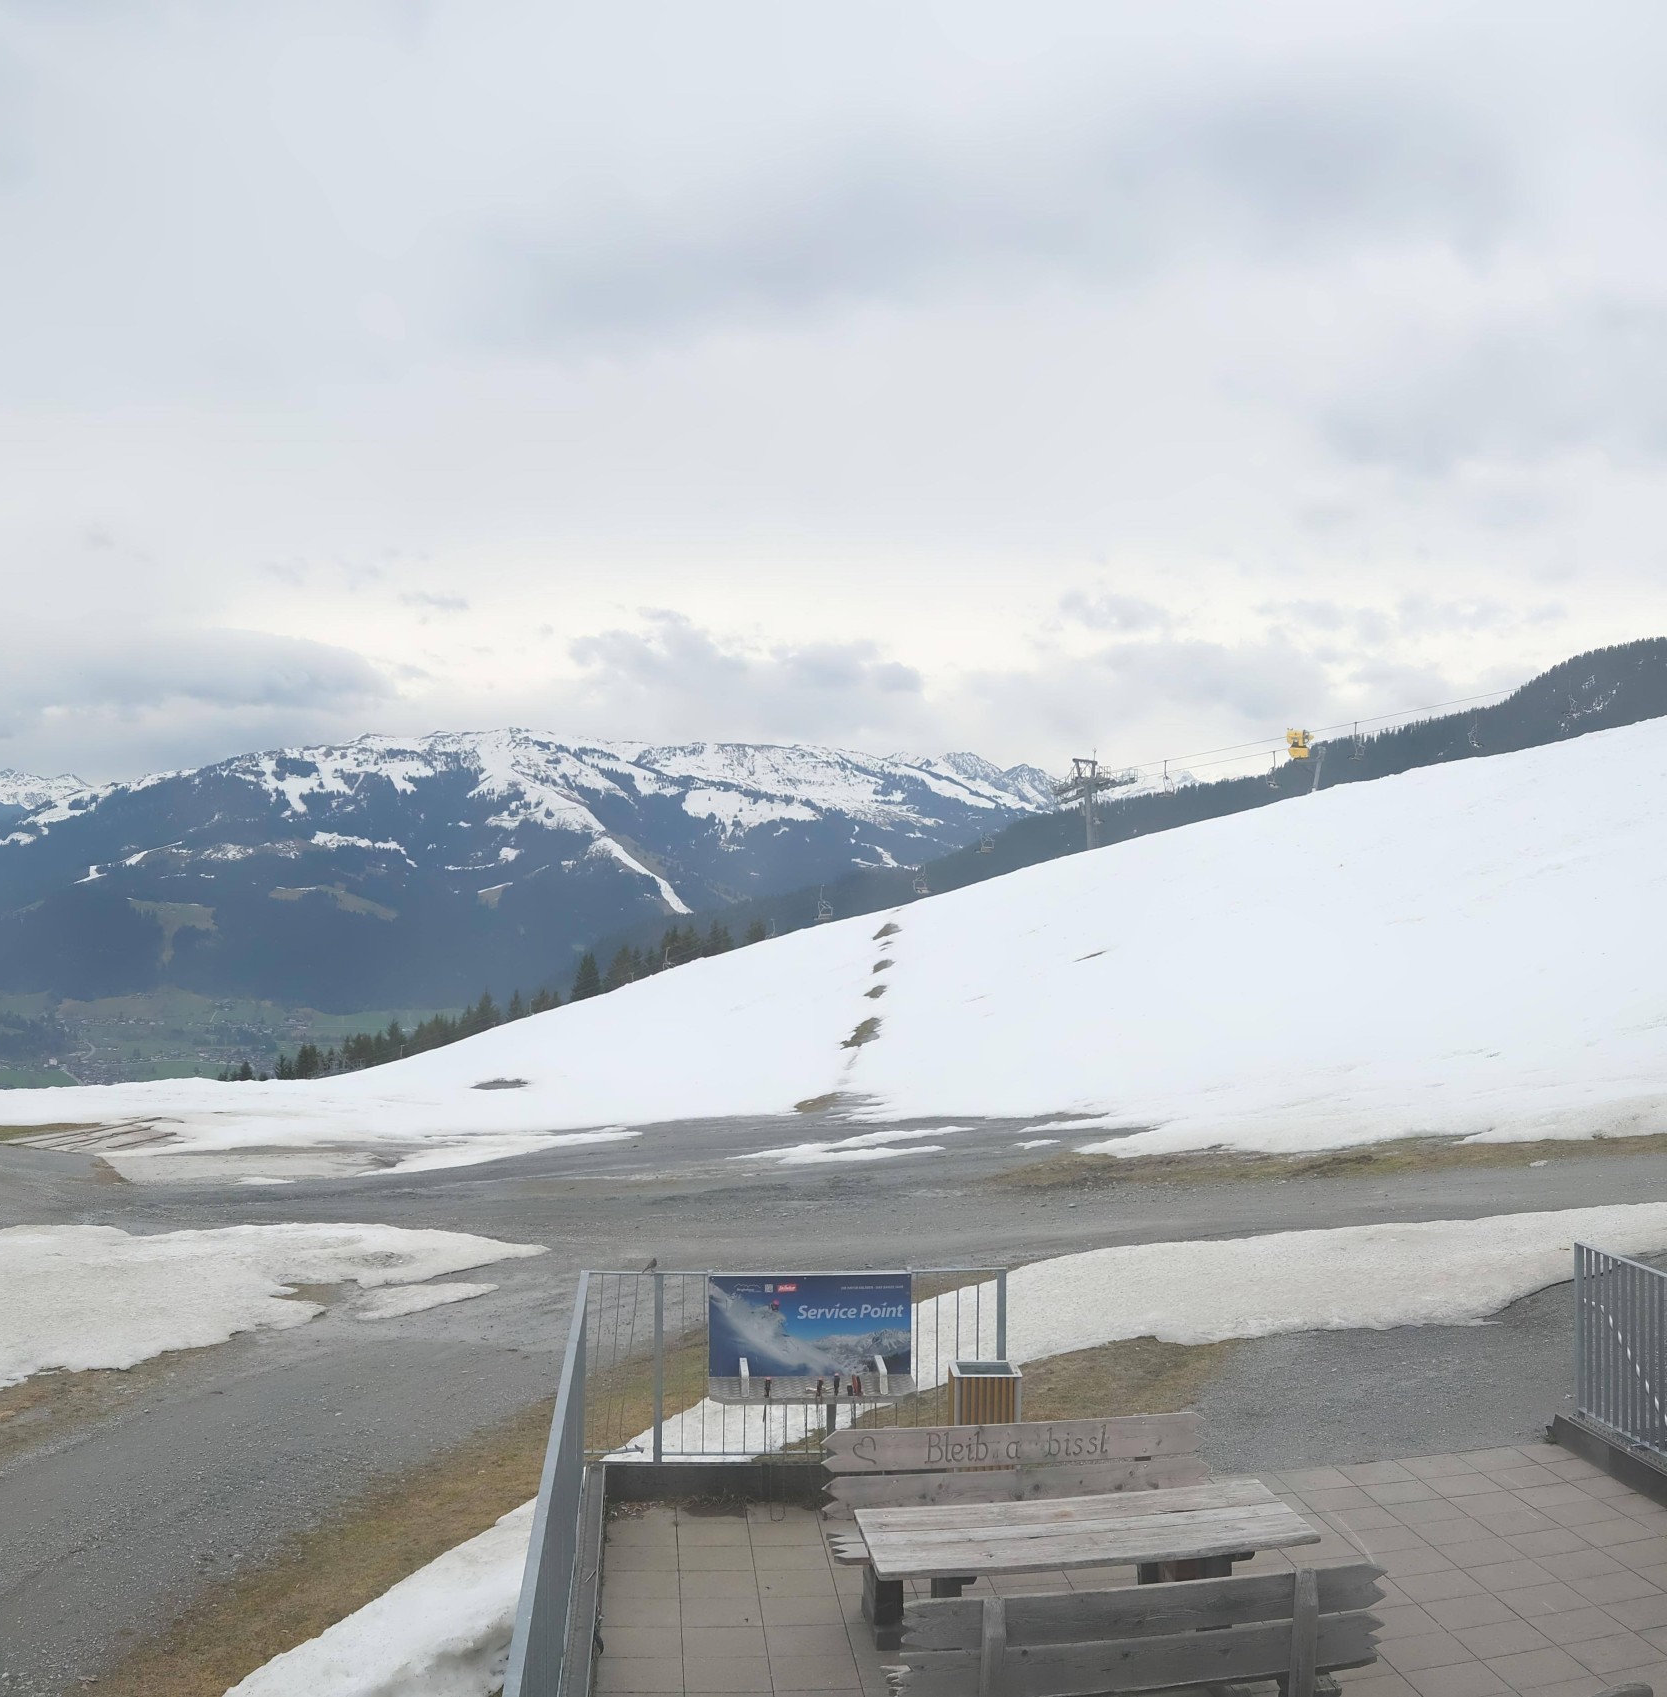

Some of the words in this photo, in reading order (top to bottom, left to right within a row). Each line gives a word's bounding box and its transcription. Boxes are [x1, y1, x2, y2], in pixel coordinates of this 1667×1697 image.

[797, 1303, 856, 1319] Service
[859, 1302, 903, 1318] Point
[924, 1431, 989, 1464] Bleib
[1044, 1423, 1108, 1458] bissl
